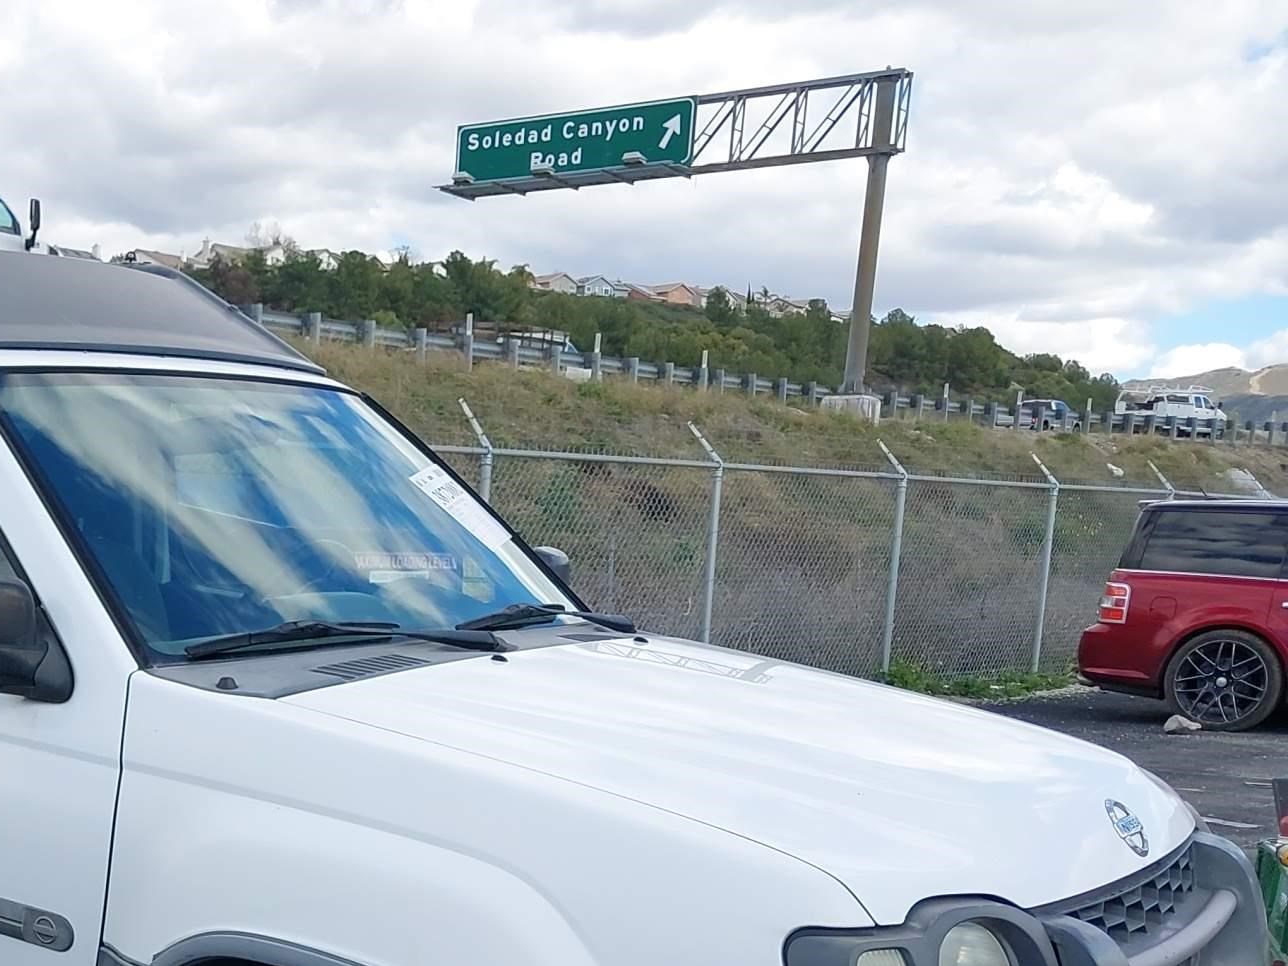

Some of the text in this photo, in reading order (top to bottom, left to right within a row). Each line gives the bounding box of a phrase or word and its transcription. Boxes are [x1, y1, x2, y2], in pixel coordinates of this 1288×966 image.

[467, 115, 645, 151] Soledad Canyon
[530, 147, 583, 167] Road
